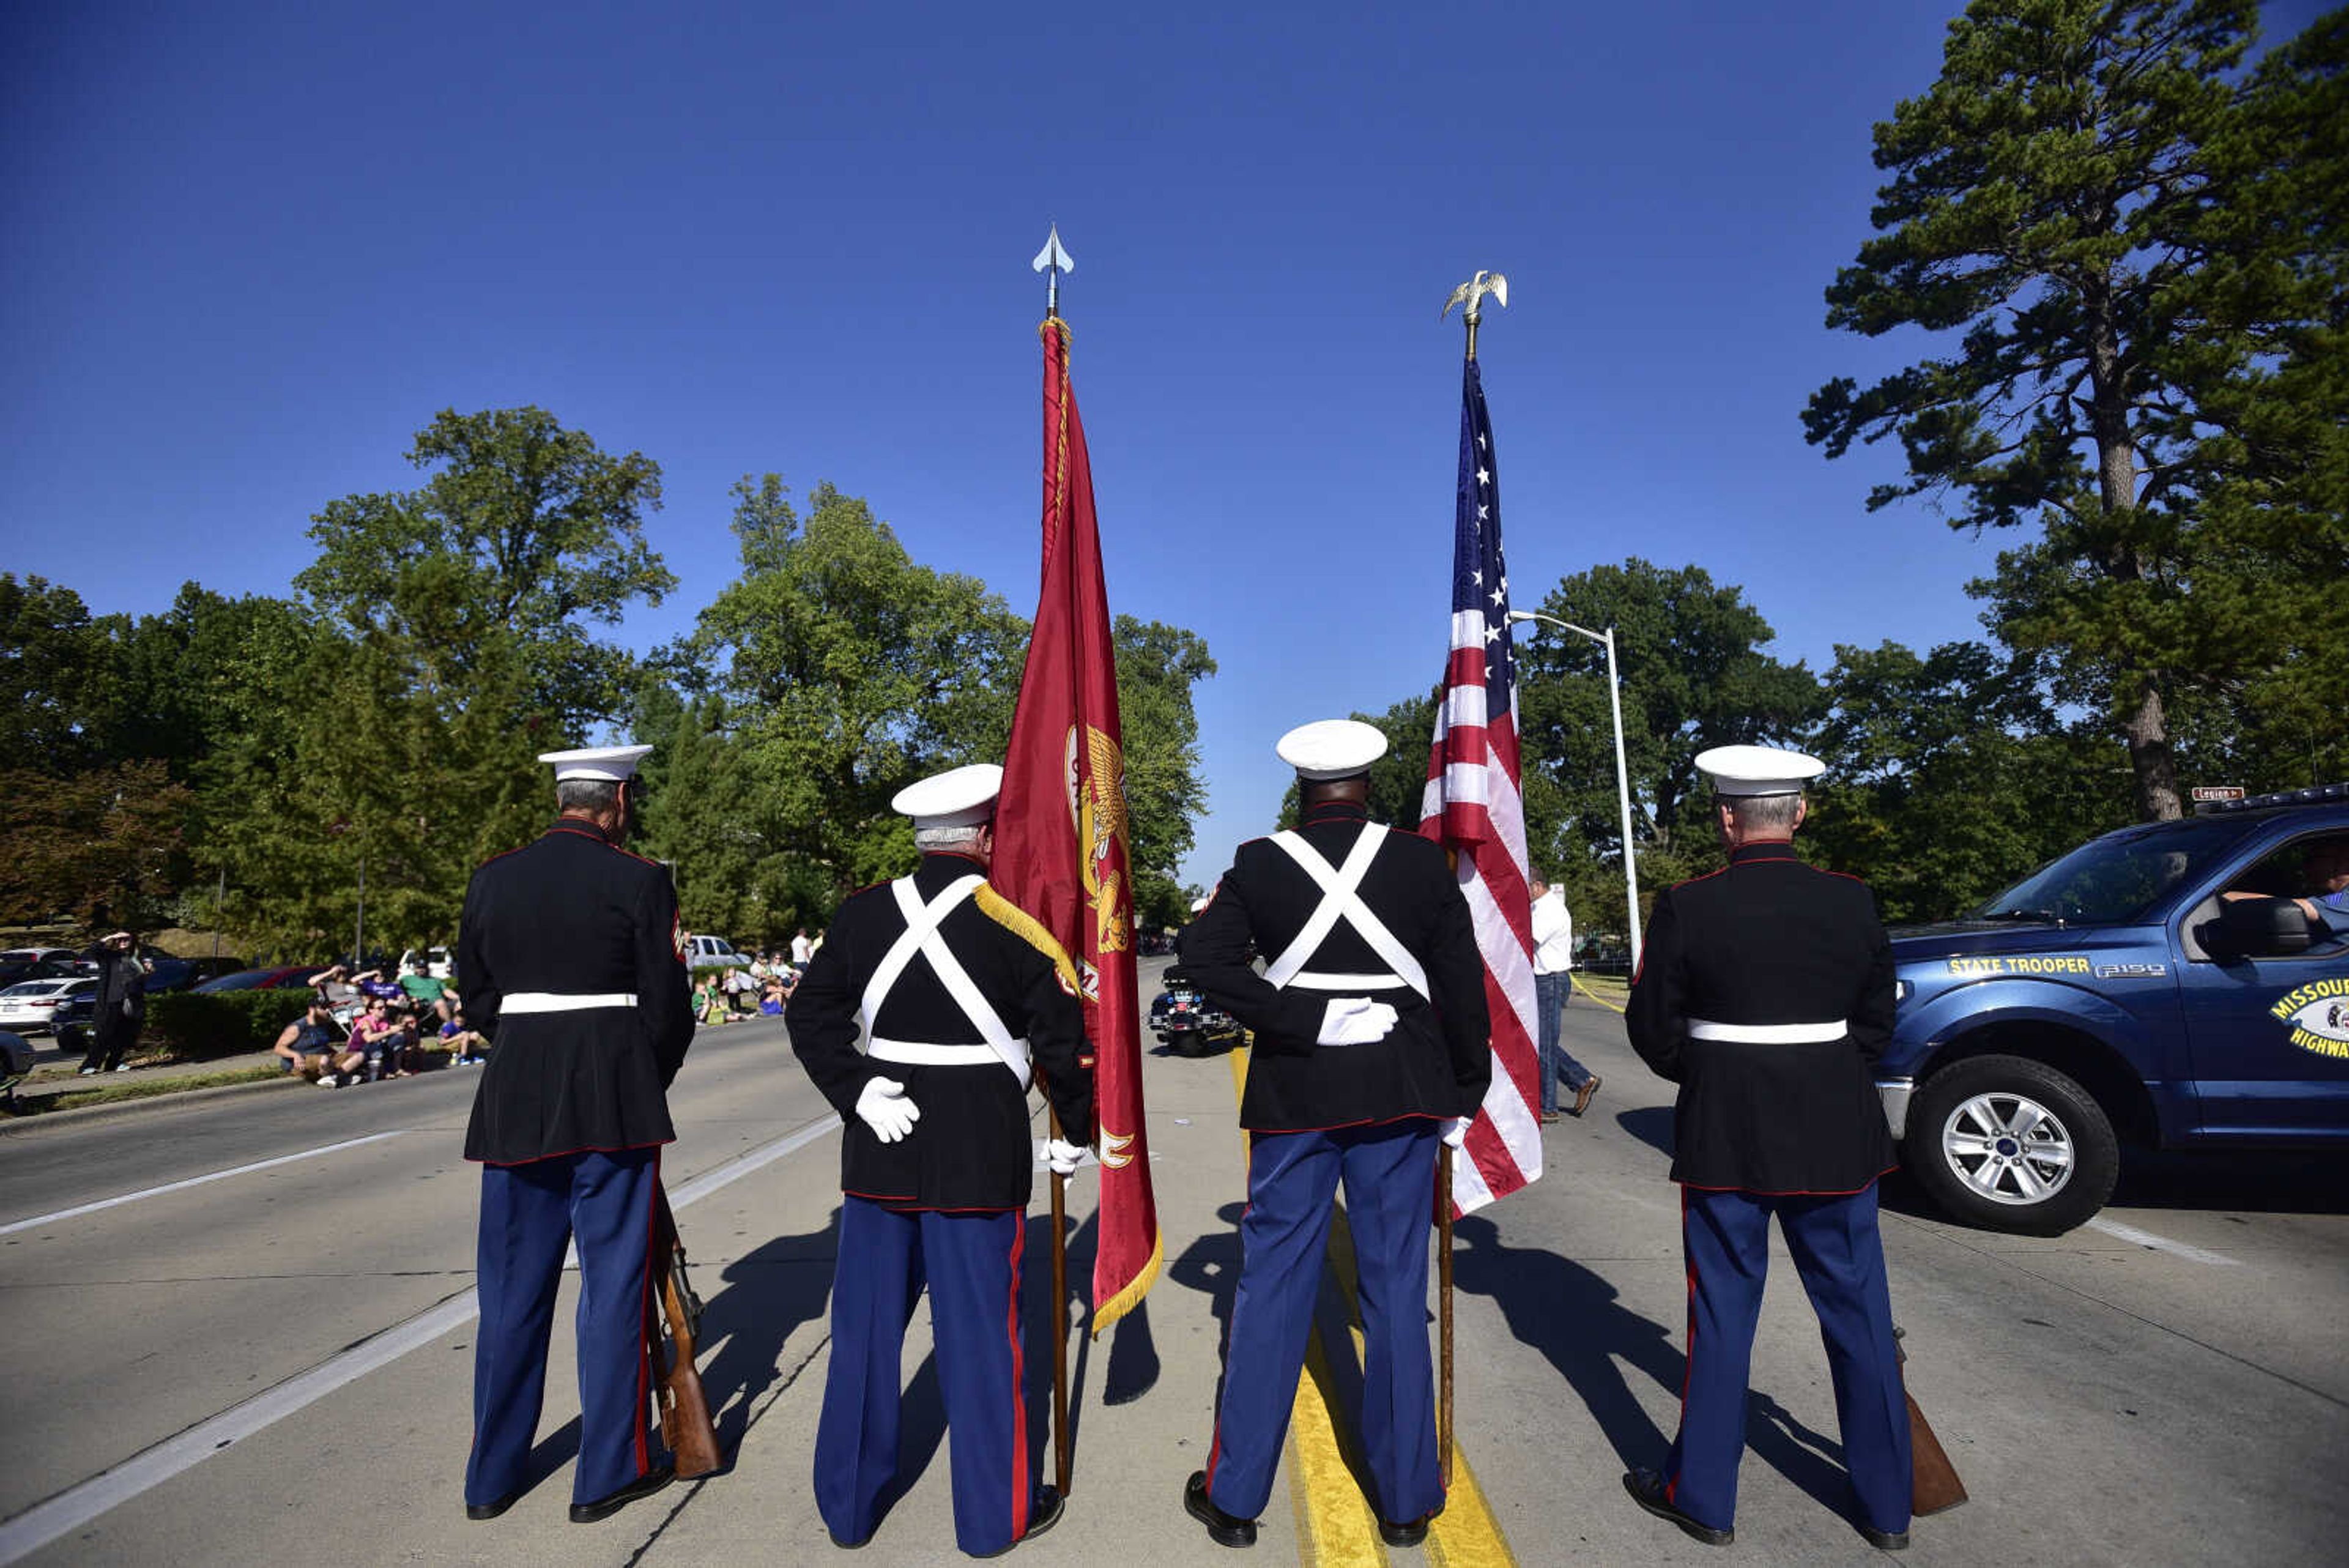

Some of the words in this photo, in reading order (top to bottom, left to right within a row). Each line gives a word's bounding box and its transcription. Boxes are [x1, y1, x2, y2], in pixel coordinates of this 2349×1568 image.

[1950, 959, 2003, 974] STATE
[2006, 957, 2090, 973] TROOPER
[2290, 1028, 2349, 1058] HIGHWA
